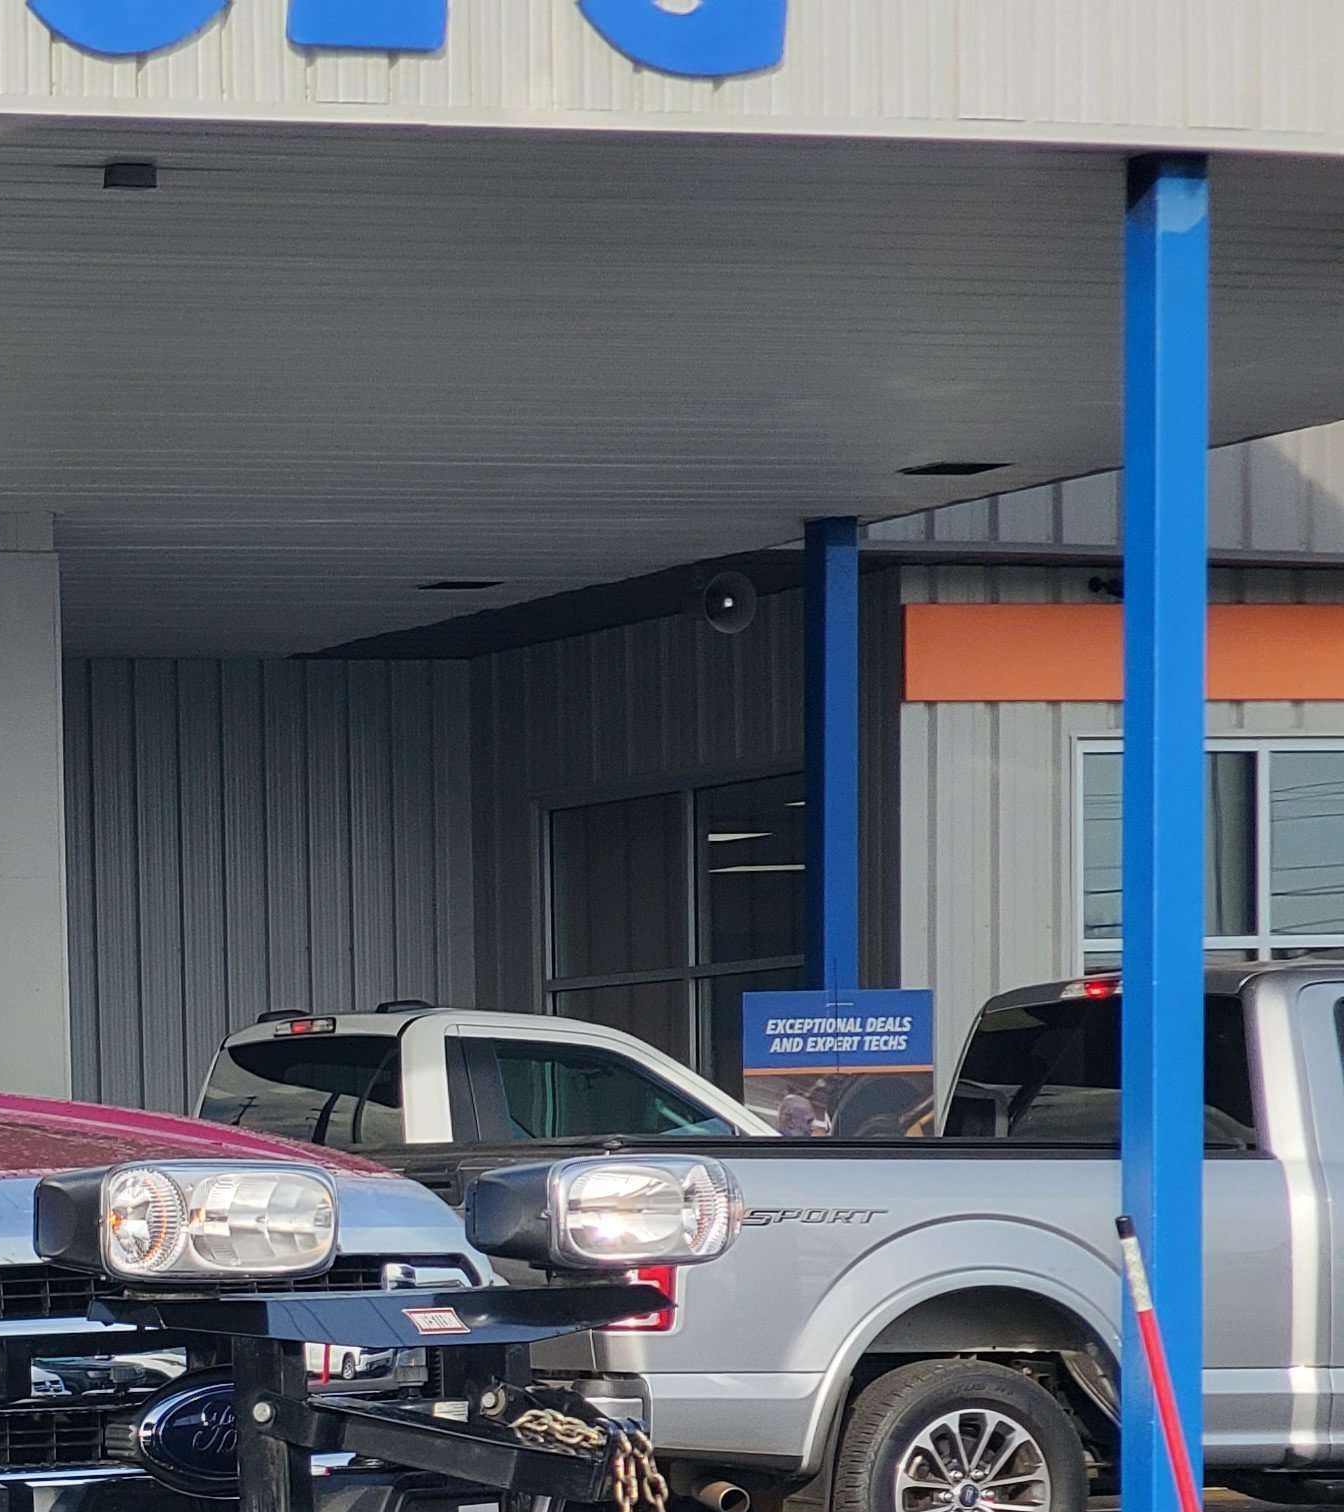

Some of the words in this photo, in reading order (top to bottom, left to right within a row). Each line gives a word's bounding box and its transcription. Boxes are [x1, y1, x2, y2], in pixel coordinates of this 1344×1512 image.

[765, 1017, 862, 1035] EXCEPTIONAL
[866, 1016, 912, 1033] DEALS
[769, 1038, 803, 1053] AND
[805, 1036, 861, 1052] EXPERT
[864, 1035, 908, 1051] TECHS
[741, 1207, 889, 1227] SPORT
